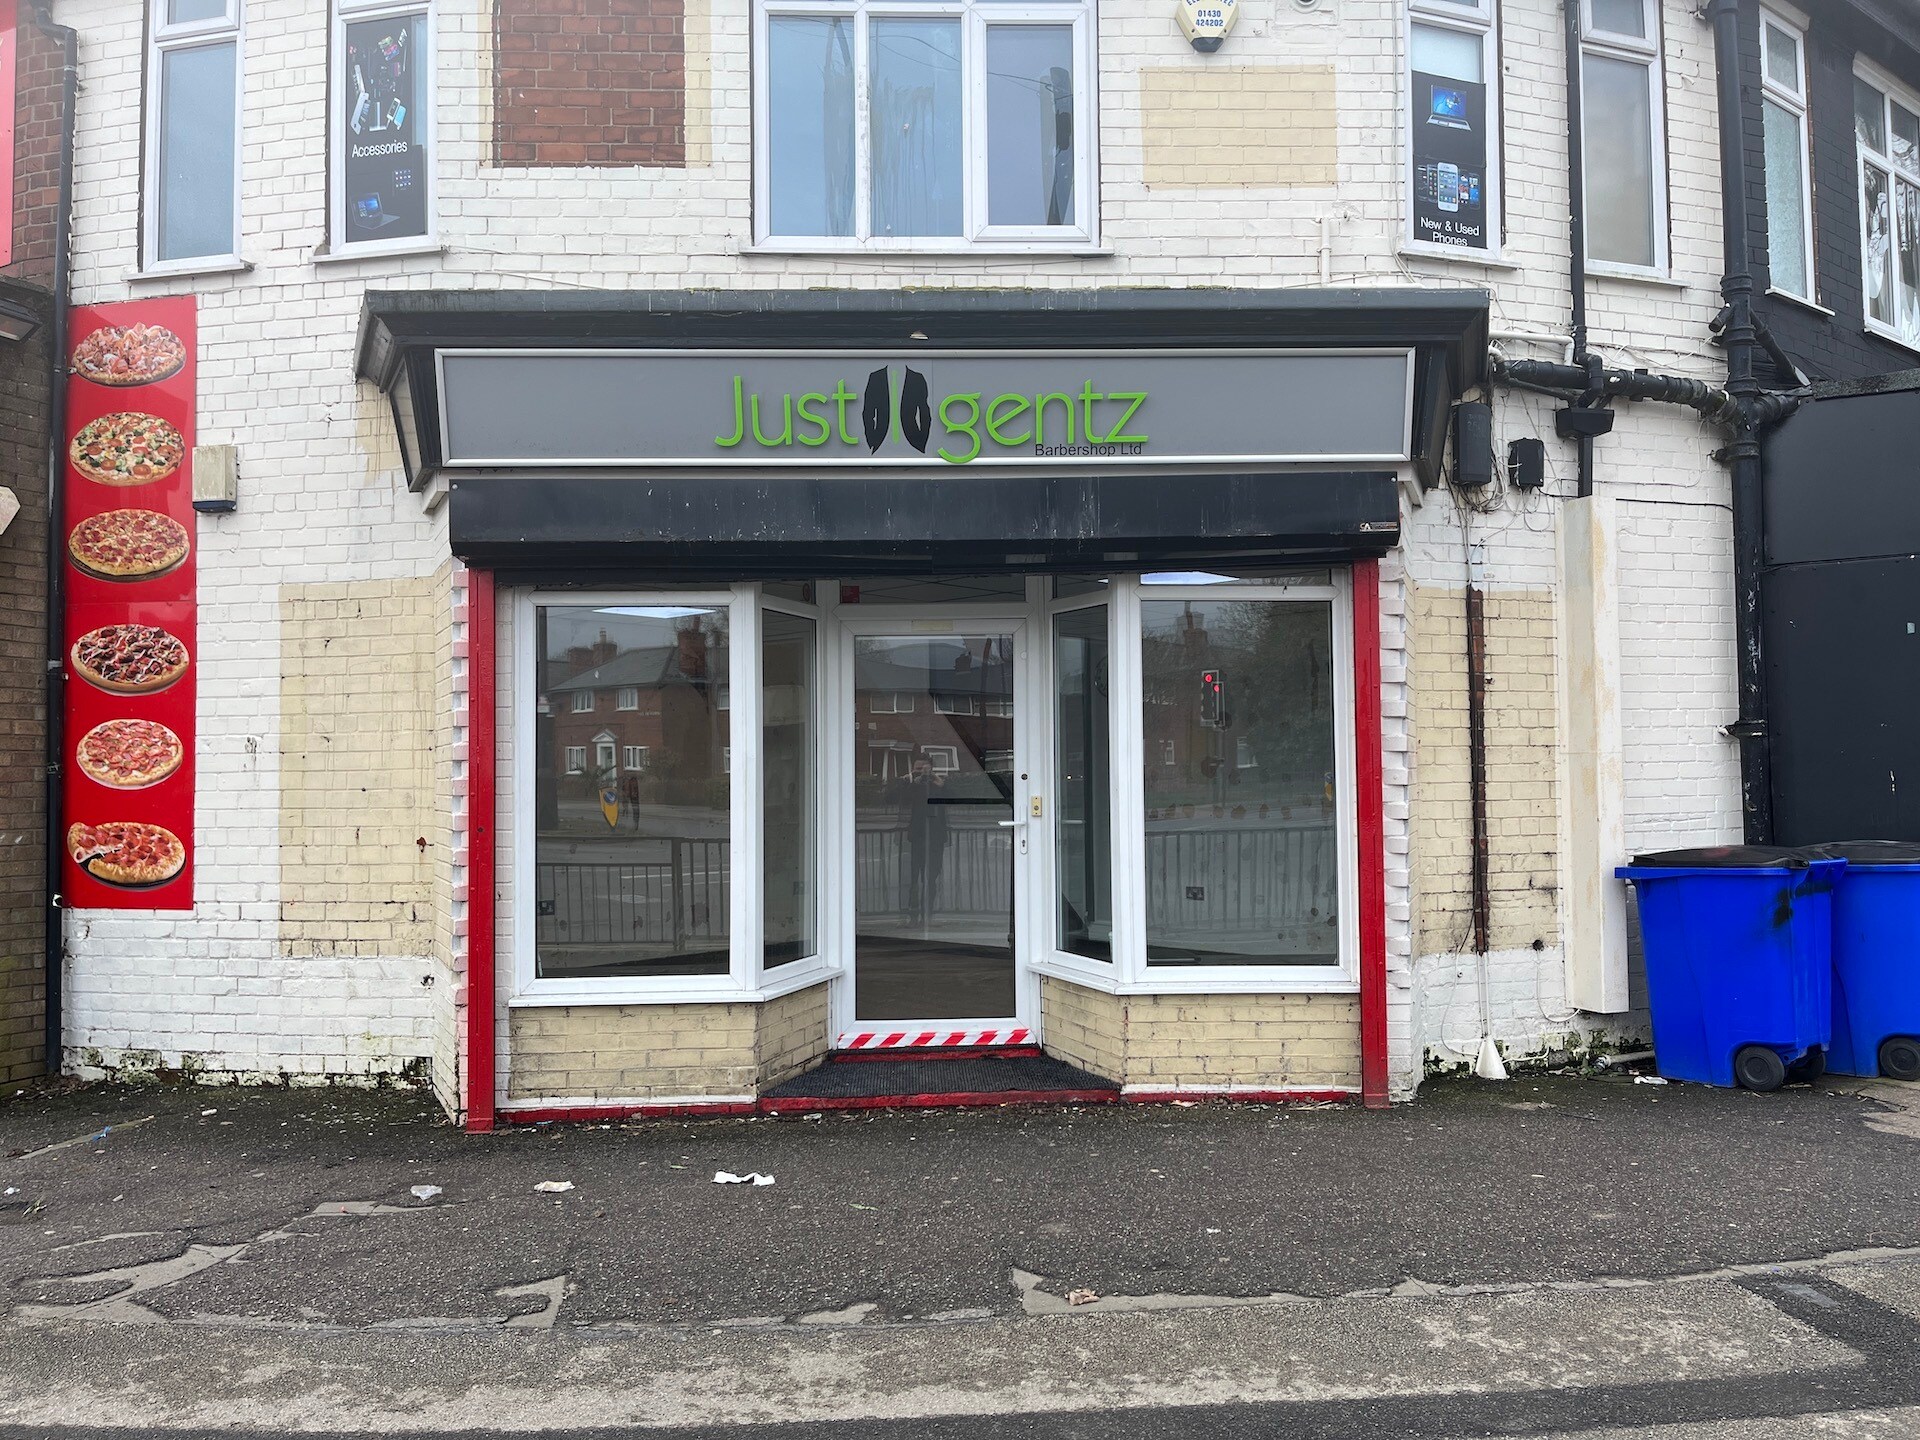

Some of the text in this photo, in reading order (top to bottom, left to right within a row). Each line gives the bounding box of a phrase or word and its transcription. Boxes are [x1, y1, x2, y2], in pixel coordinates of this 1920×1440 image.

[1197, 9, 1222, 18] 01430
[1195, 19, 1224, 27] 424202
[351, 139, 408, 158] Accessories
[1420, 216, 1480, 236] New & Used
[1432, 231, 1468, 246] Phones
[714, 375, 1149, 464] Just gentz
[1035, 442, 1142, 457] Barbershop Ltd
